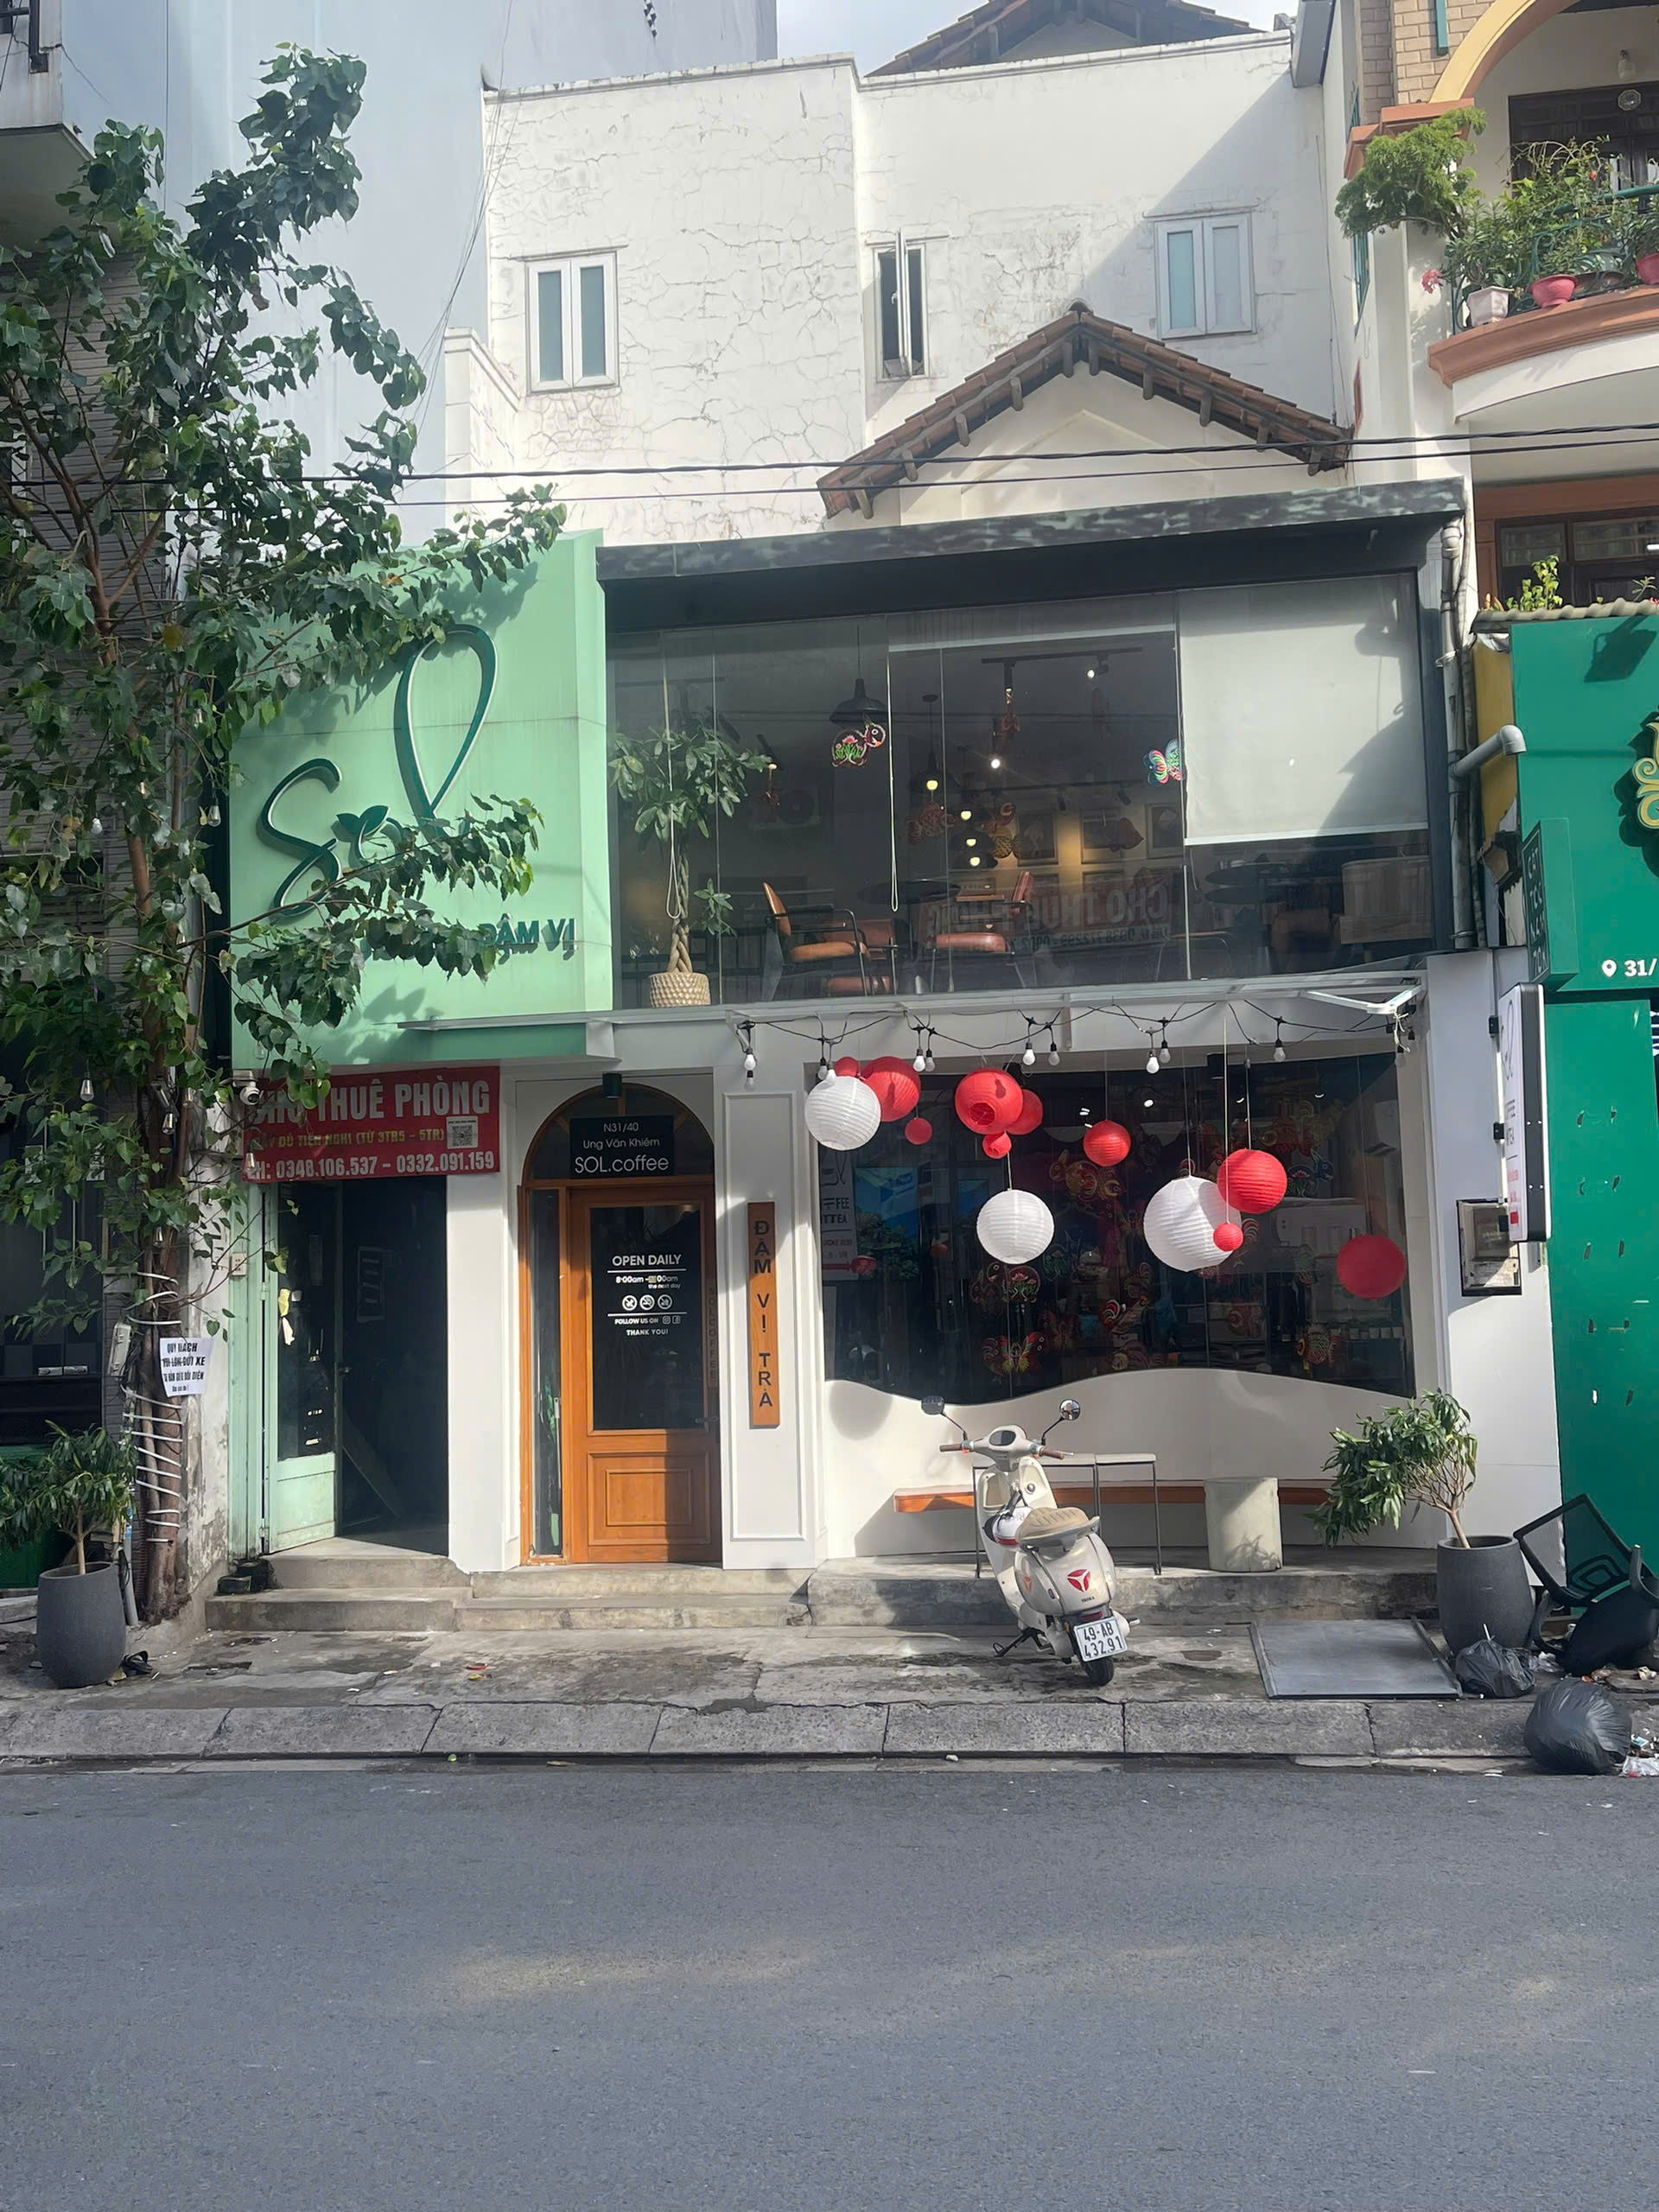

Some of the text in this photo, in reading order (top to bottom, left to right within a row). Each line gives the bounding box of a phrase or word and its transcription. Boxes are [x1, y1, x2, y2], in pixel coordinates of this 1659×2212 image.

[395, 1075, 491, 1118] PHÒNG
[603, 1122, 639, 1133] N31/40
[583, 1137, 660, 1151] Ung Văn Khiêm
[396, 1151, 495, 1173] 0332.091.159
[575, 1155, 669, 1173] SOL.coffee
[612, 1254, 682, 1266] OPEN DAILY
[195, 1356, 207, 1365] XE
[759, 1352, 773, 1408] TRÀ
[1084, 1623, 1112, 1641] 49-AB
[1085, 1637, 1122, 1657] 432.91
